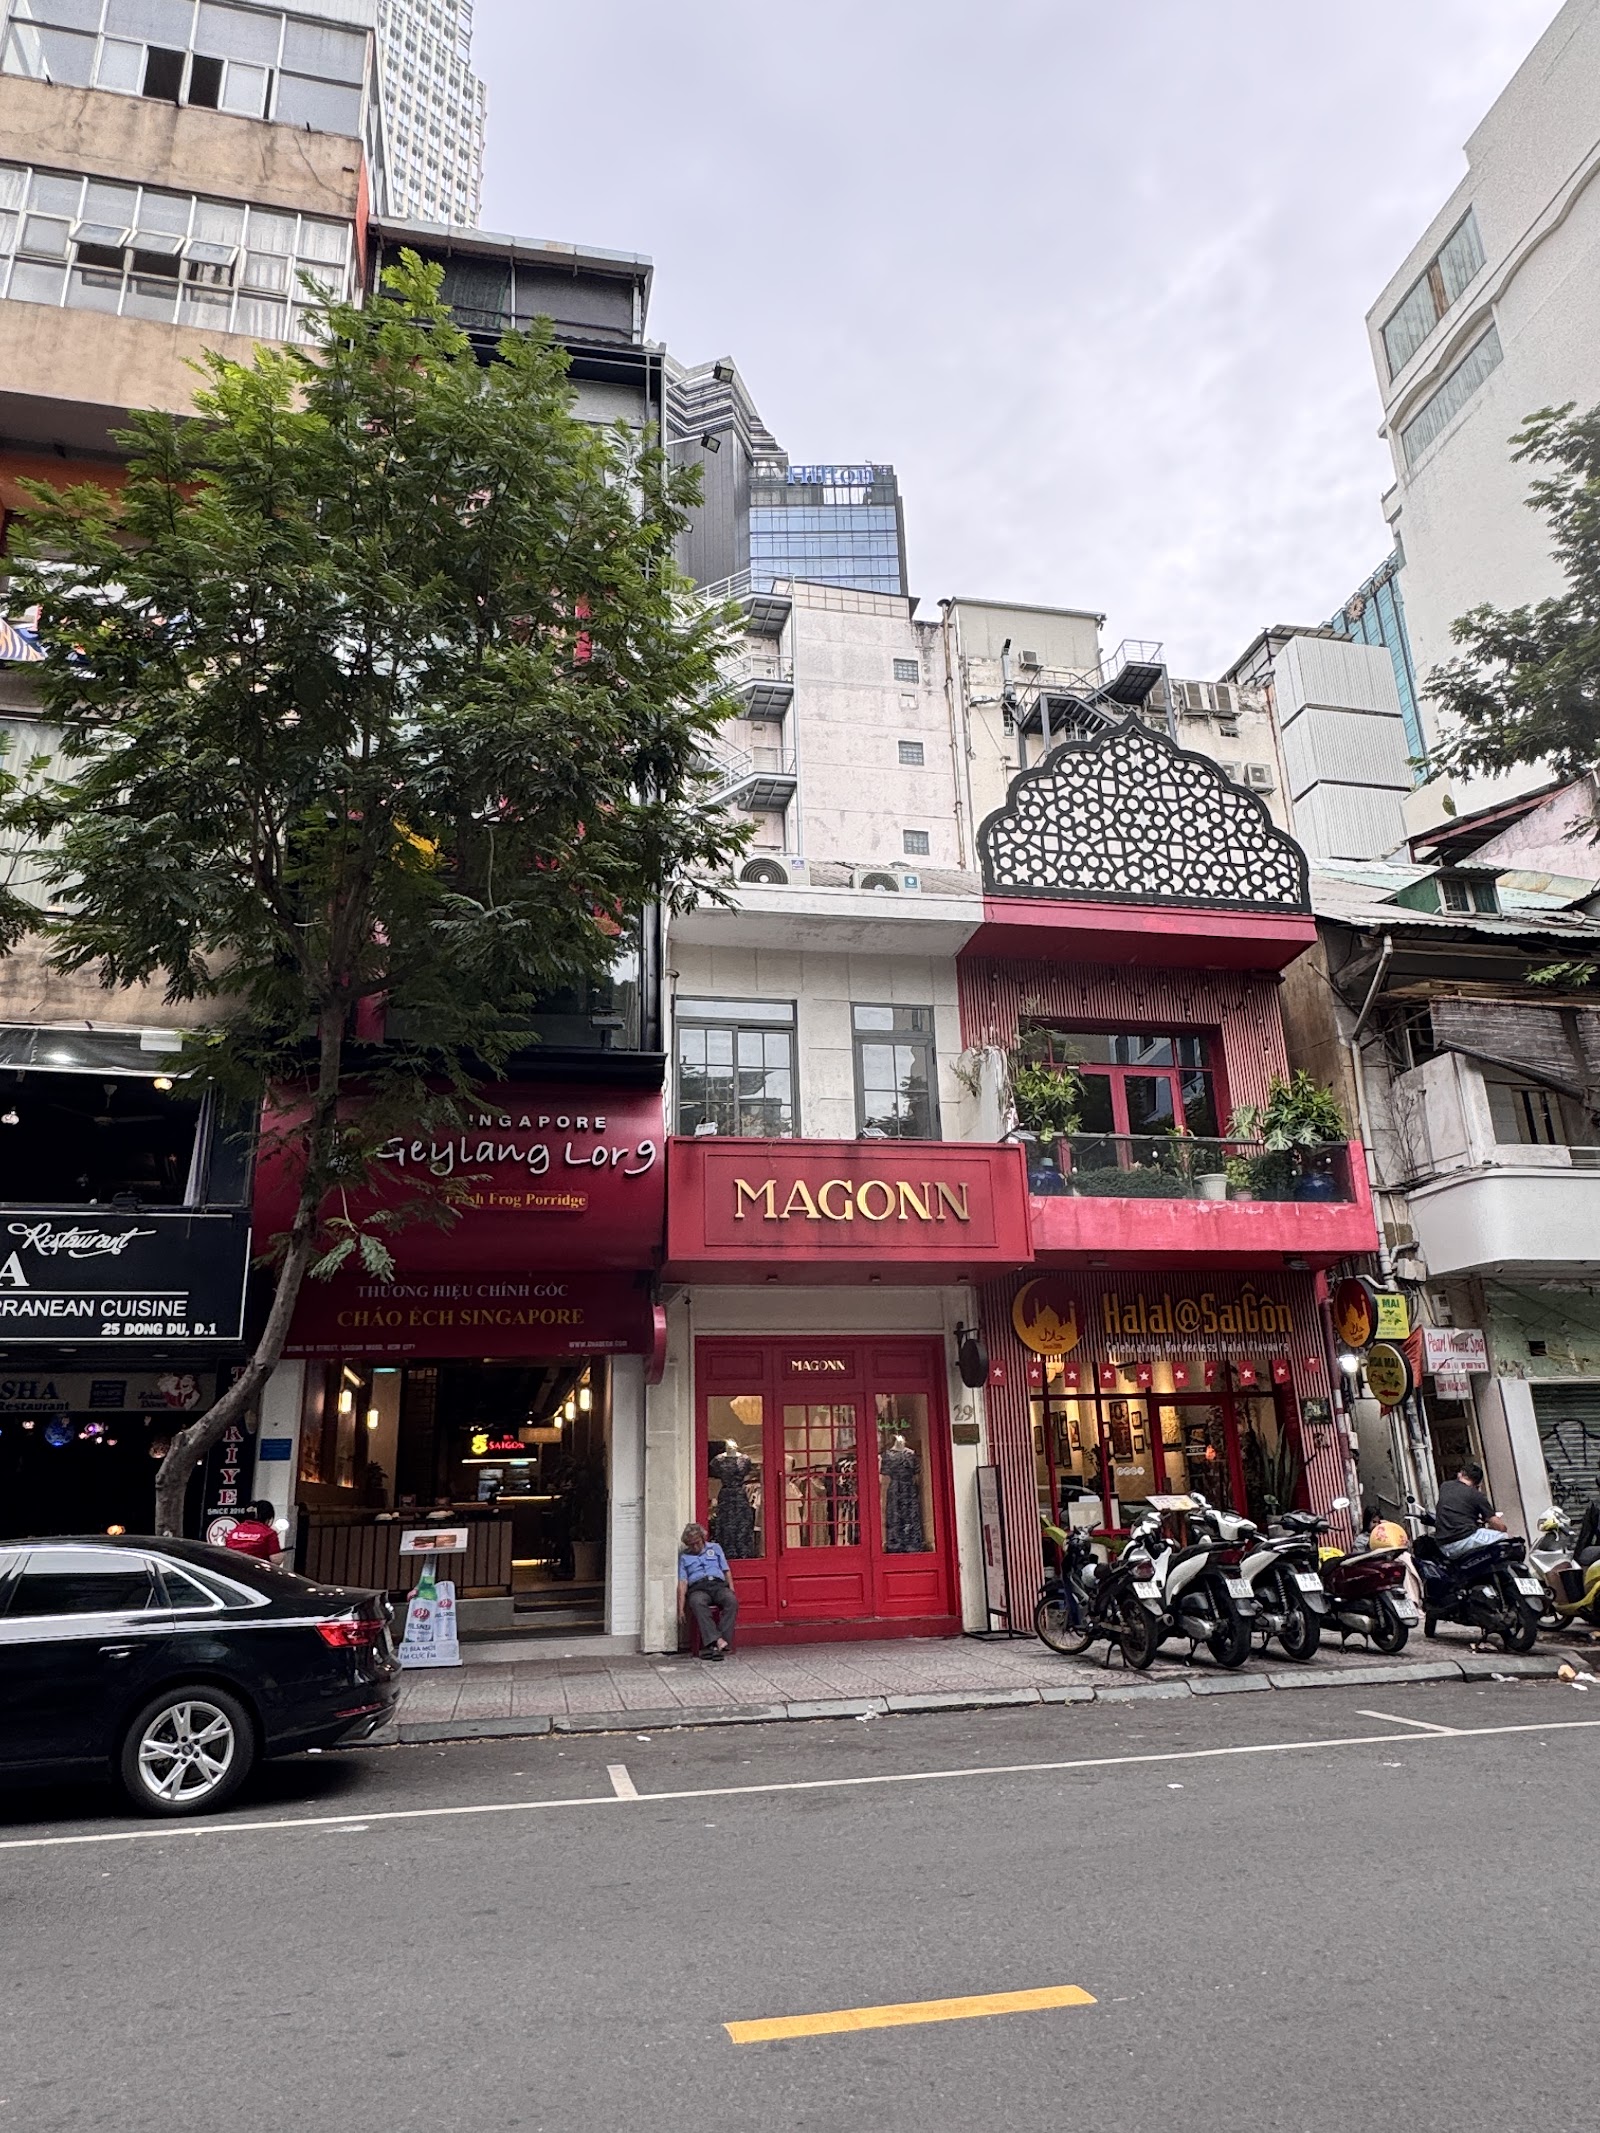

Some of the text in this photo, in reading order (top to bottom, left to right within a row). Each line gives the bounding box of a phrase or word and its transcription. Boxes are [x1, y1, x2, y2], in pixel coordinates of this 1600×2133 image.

[787, 465, 876, 485] Hilton
[469, 1115, 607, 1131] INGAPORE
[488, 1193, 522, 1208] Frog
[525, 1193, 587, 1209] Porridge
[734, 1179, 970, 1221] MAGONN
[8, 1222, 157, 1258] Restaurant
[0, 1251, 30, 1286] A
[0, 1300, 187, 1317] RANEAN CUISINE
[337, 1306, 403, 1327] CHÁO
[459, 1308, 585, 1326] SINGAPORE
[101, 1323, 217, 1336] 25 DONG DU, D.1
[791, 1360, 845, 1371] MAGONN
[1, 1380, 59, 1399] SHA
[953, 1405, 973, 1422] 29
